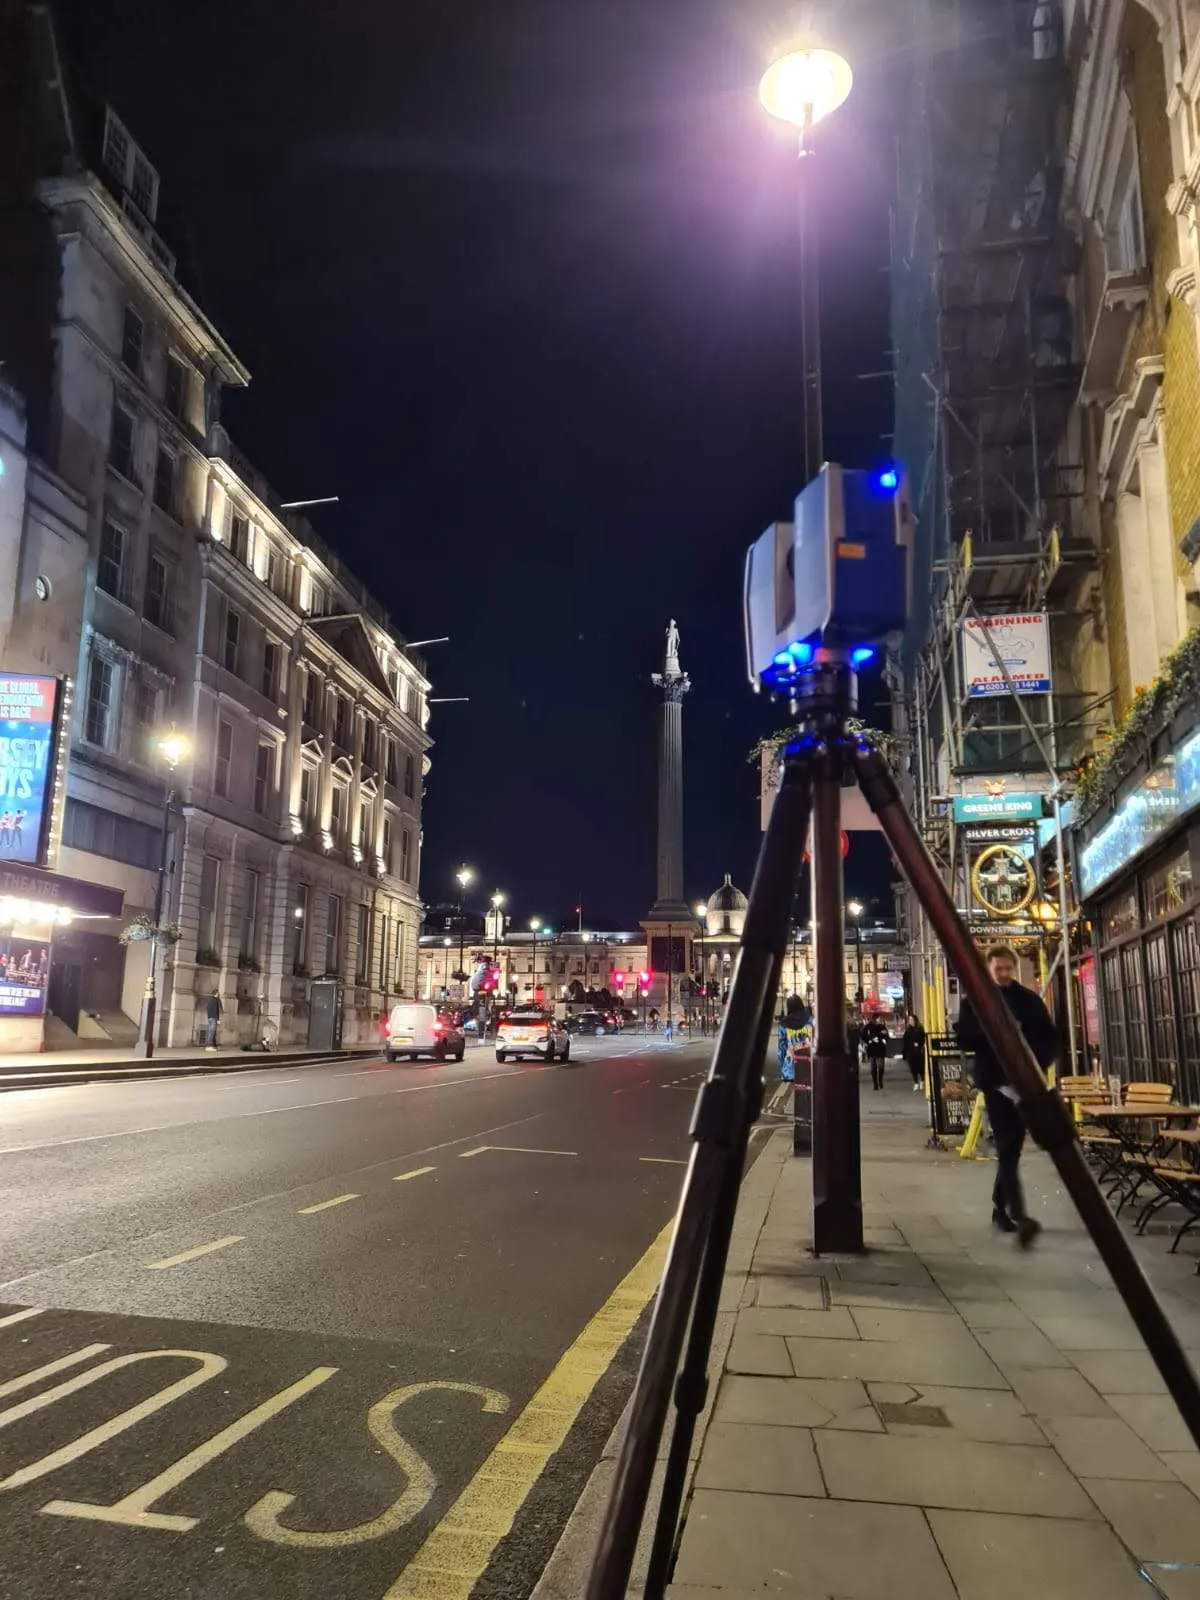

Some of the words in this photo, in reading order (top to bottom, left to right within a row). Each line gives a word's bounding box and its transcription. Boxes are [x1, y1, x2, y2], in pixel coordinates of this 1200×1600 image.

[967, 616, 1043, 628] WARNING
[963, 803, 1003, 813] GREENE
[1004, 802, 1033, 812] KING
[966, 829, 1000, 839] SILVER
[1001, 828, 1035, 837] CROSS
[3, 872, 61, 897] THEATRE
[1026, 925, 1044, 933] BAR
[0, 1343, 511, 1548] STO
